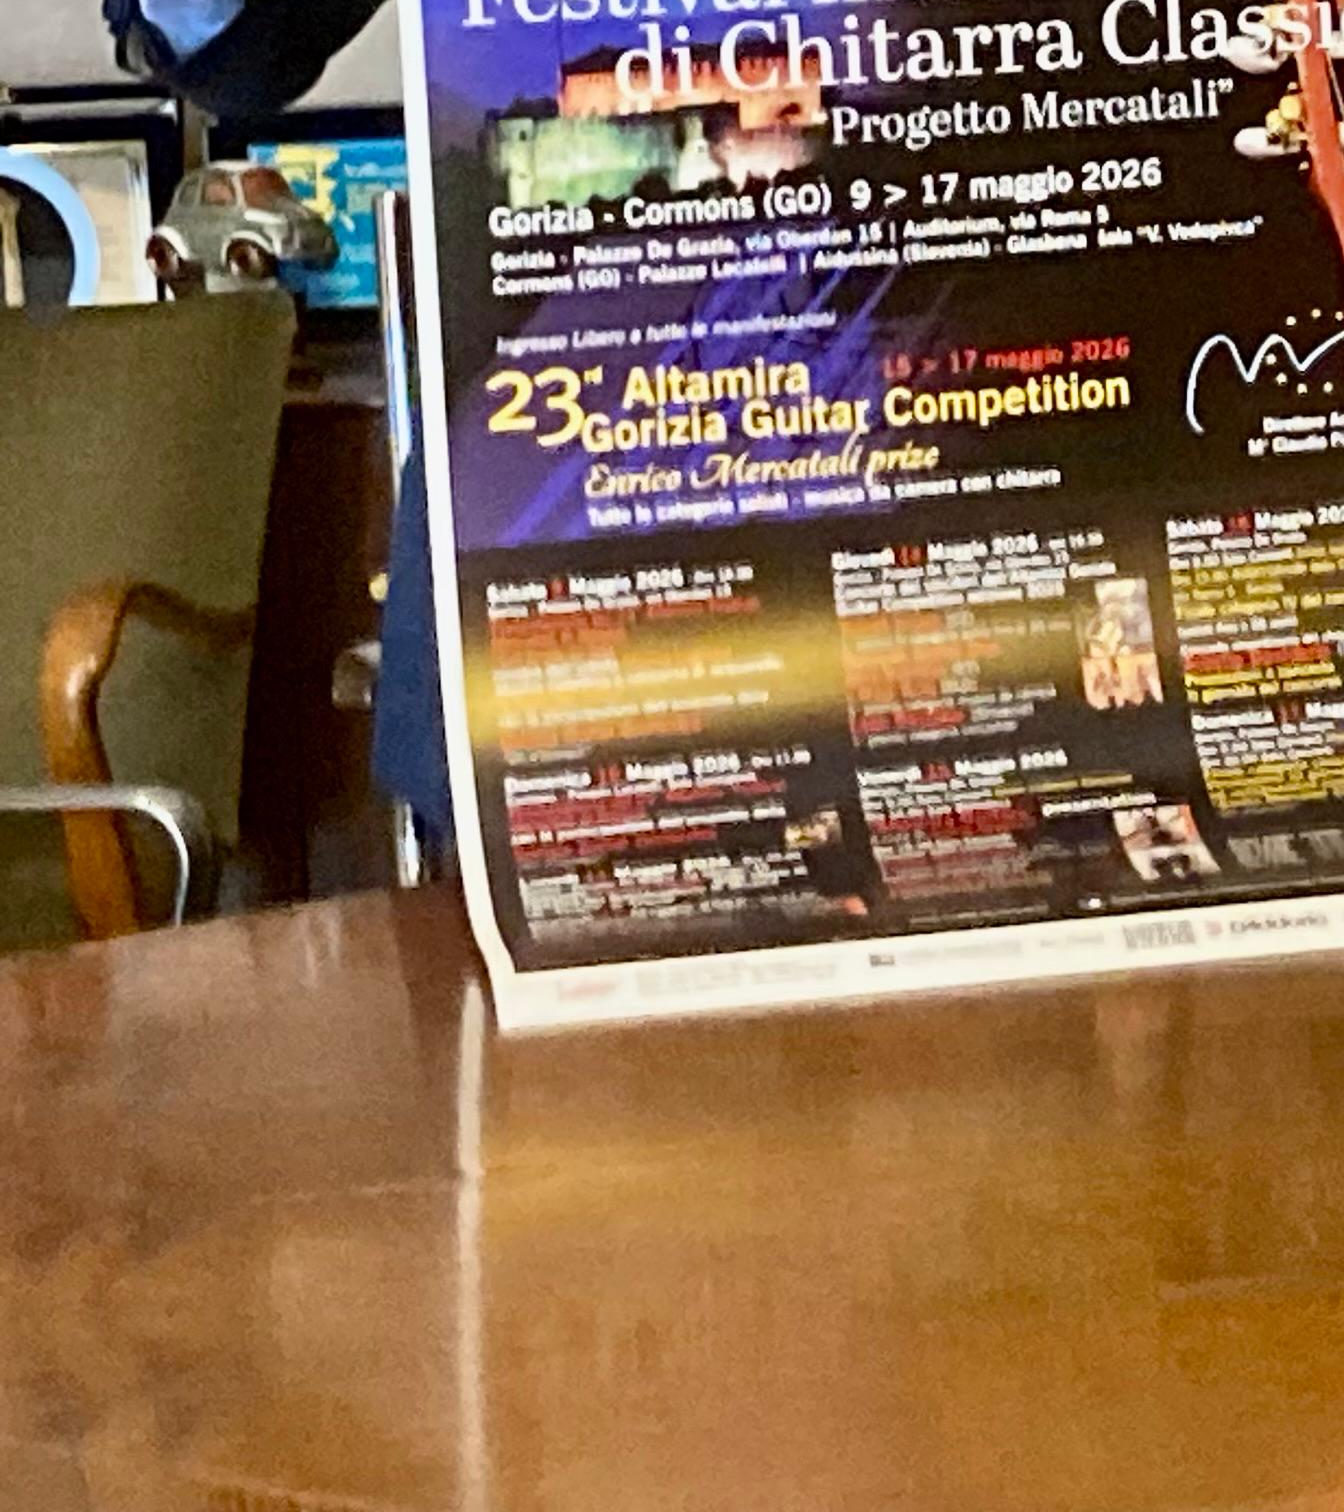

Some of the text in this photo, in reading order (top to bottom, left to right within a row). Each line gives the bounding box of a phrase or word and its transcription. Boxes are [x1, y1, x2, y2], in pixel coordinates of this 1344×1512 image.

[614, 22, 693, 101] di
[719, 13, 1083, 93] Chitarra
[488, 204, 594, 238] Gorizia
[763, 182, 832, 219] (GO)
[850, 178, 872, 210] 9
[921, 172, 959, 205] 17
[970, 165, 1073, 204] maggio
[1081, 157, 1162, 192] 2026
[621, 356, 810, 411] Altamira
[1070, 337, 1131, 363] 2026
[581, 371, 1131, 453] Gorizia Guitar Competition
[584, 462, 682, 499] Enrico
[865, 440, 940, 487] prize
